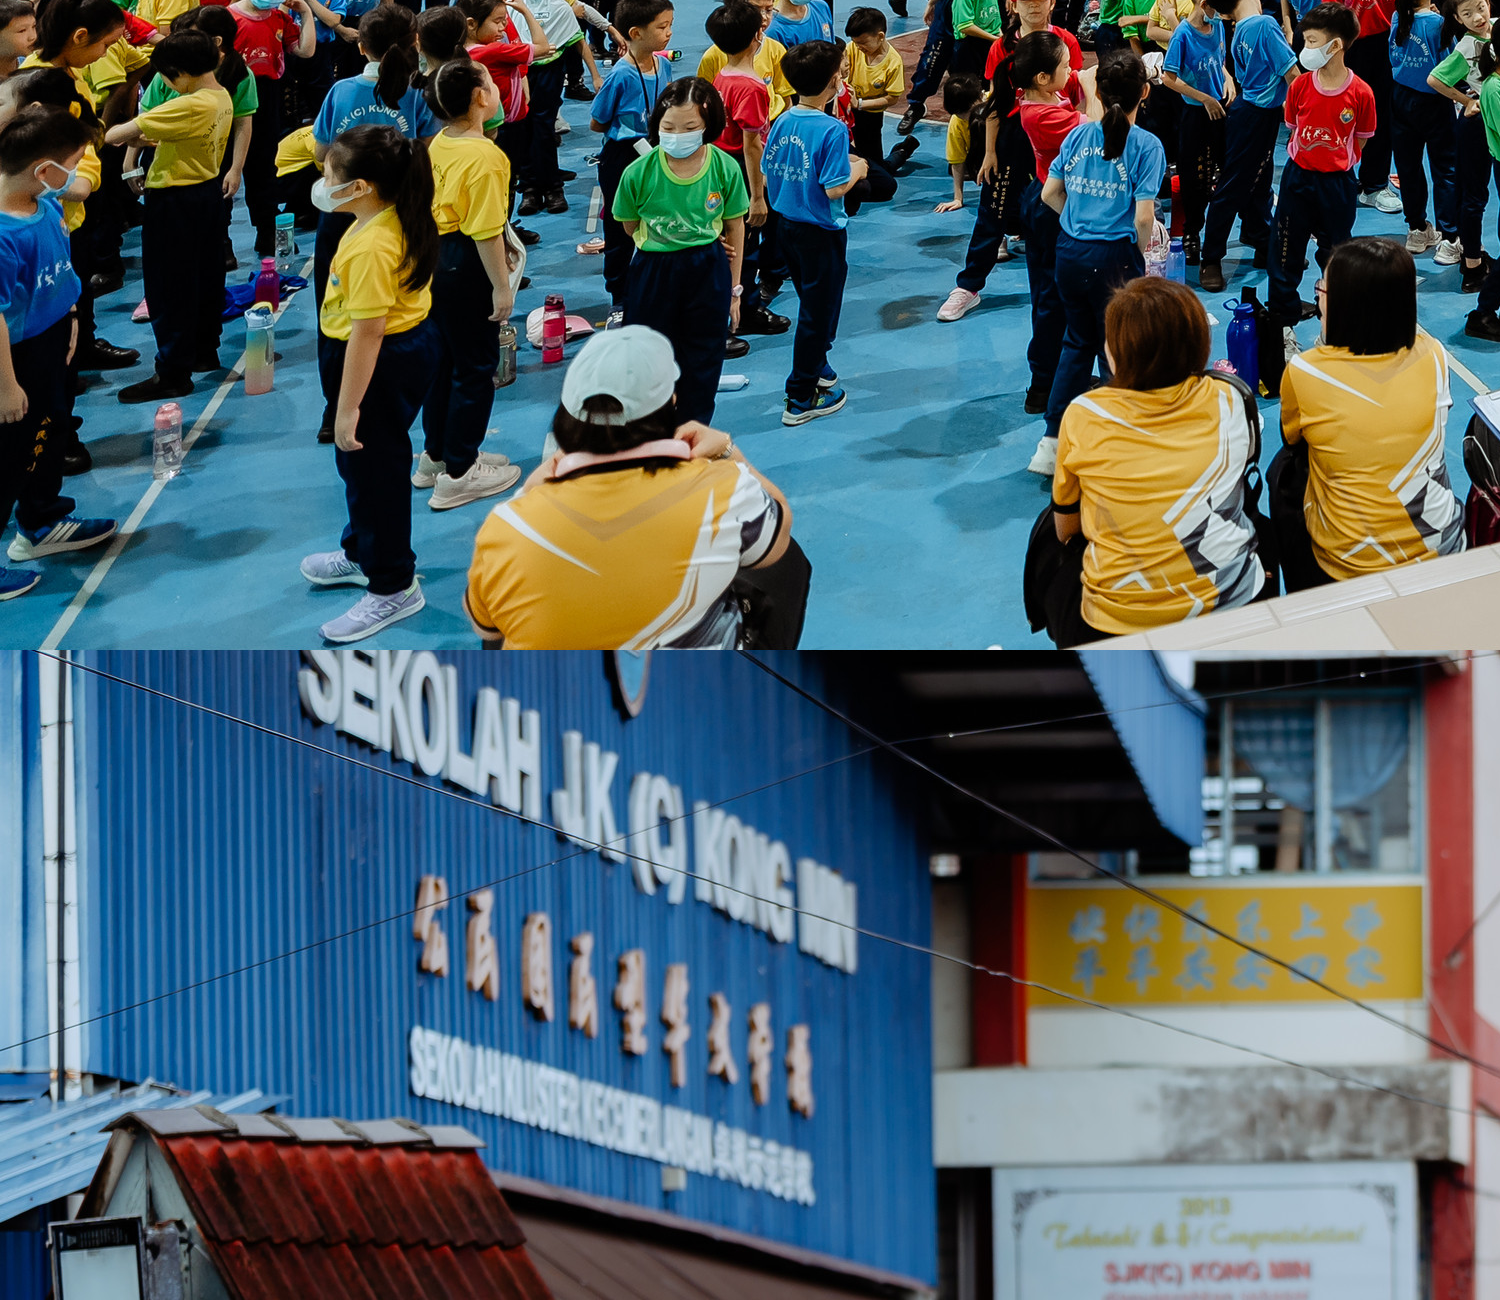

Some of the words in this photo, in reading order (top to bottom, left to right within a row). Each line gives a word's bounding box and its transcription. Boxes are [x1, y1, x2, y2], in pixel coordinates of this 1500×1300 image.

[1408, 33, 1422, 48] ONG
[1420, 43, 1430, 56] MIN
[202, 122, 217, 139] SJK
[335, 116, 351, 134] SJK
[351, 106, 366, 120] (C)
[368, 104, 399, 119] KONG
[396, 115, 409, 133] MIN
[766, 143, 780, 161] SJK
[778, 135, 789, 147] (C)
[1064, 155, 1080, 172] SJK
[1080, 146, 1093, 159] (C)
[1115, 161, 1128, 181] MIN
[297, 650, 541, 820] SEKOLAH
[628, 770, 686, 904] (C)
[693, 798, 796, 945] KONG
[797, 855, 859, 976] MIN
[410, 1025, 500, 1116] SEKOLAH
[500, 1052, 580, 1141] KLUSTER
[580, 1079, 714, 1176] KECEMERLANGAN
[1191, 1260, 1261, 1283] KONG
[1269, 1260, 1311, 1280] MIN
